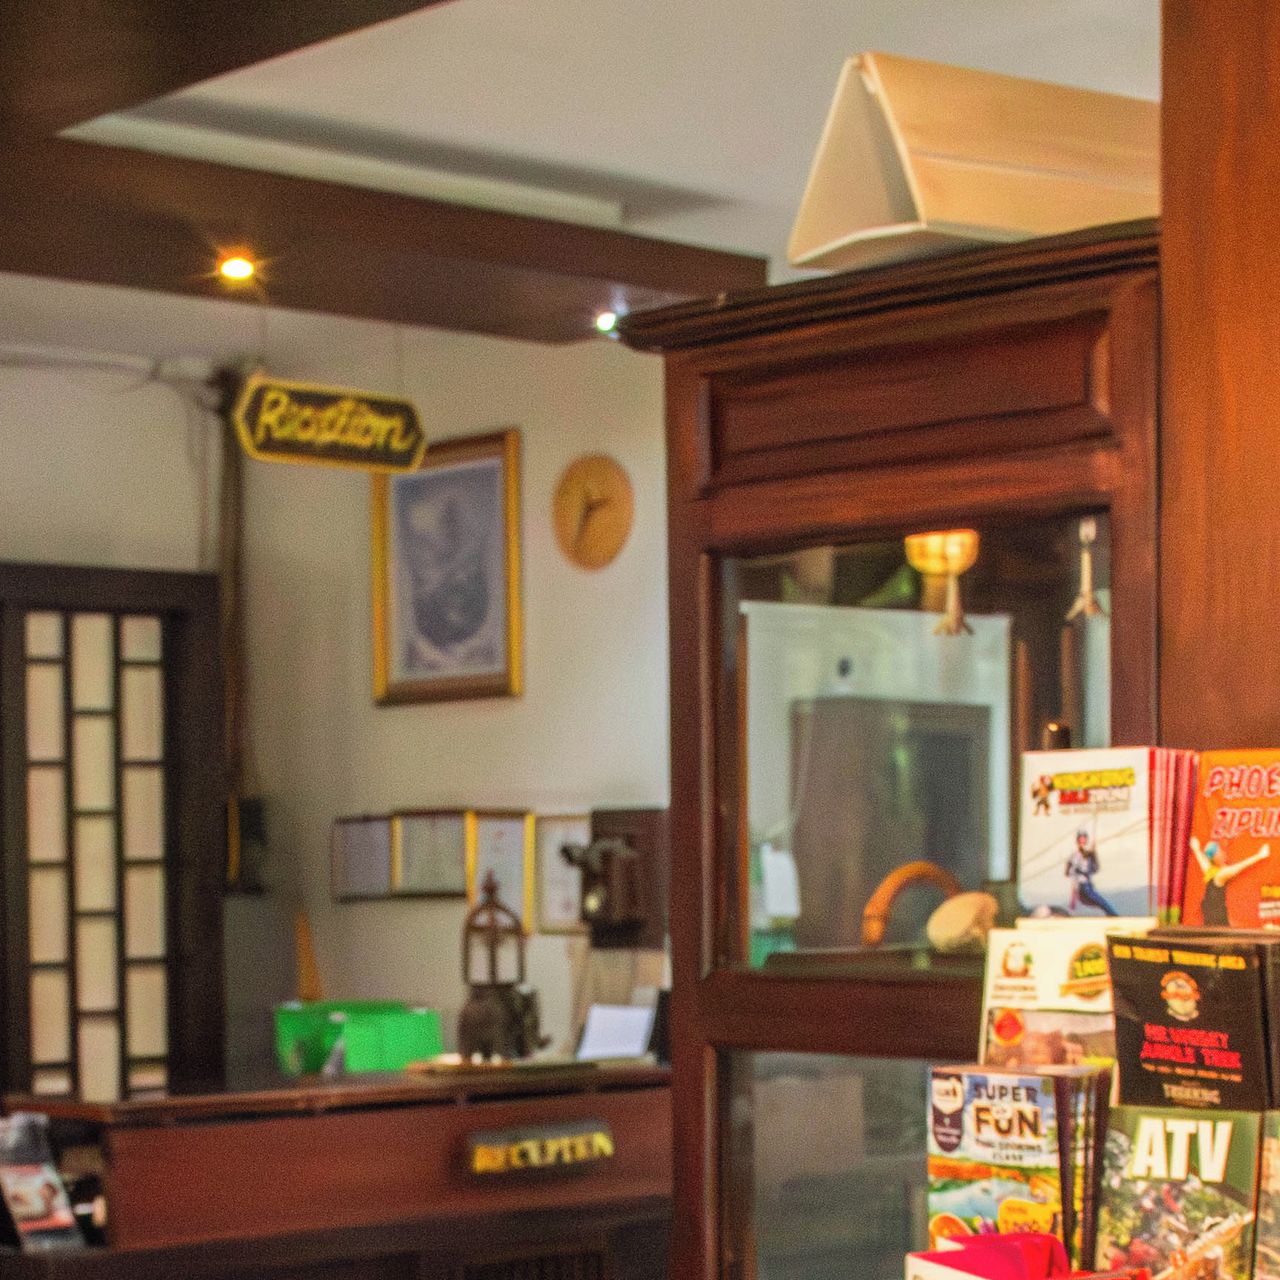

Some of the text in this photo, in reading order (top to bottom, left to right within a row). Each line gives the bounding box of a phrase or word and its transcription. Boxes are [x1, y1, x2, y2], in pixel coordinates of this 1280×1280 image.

[973, 1083, 1040, 1104] SUPER
[973, 1103, 1042, 1139] FUN
[1131, 1117, 1234, 1185] ATV
